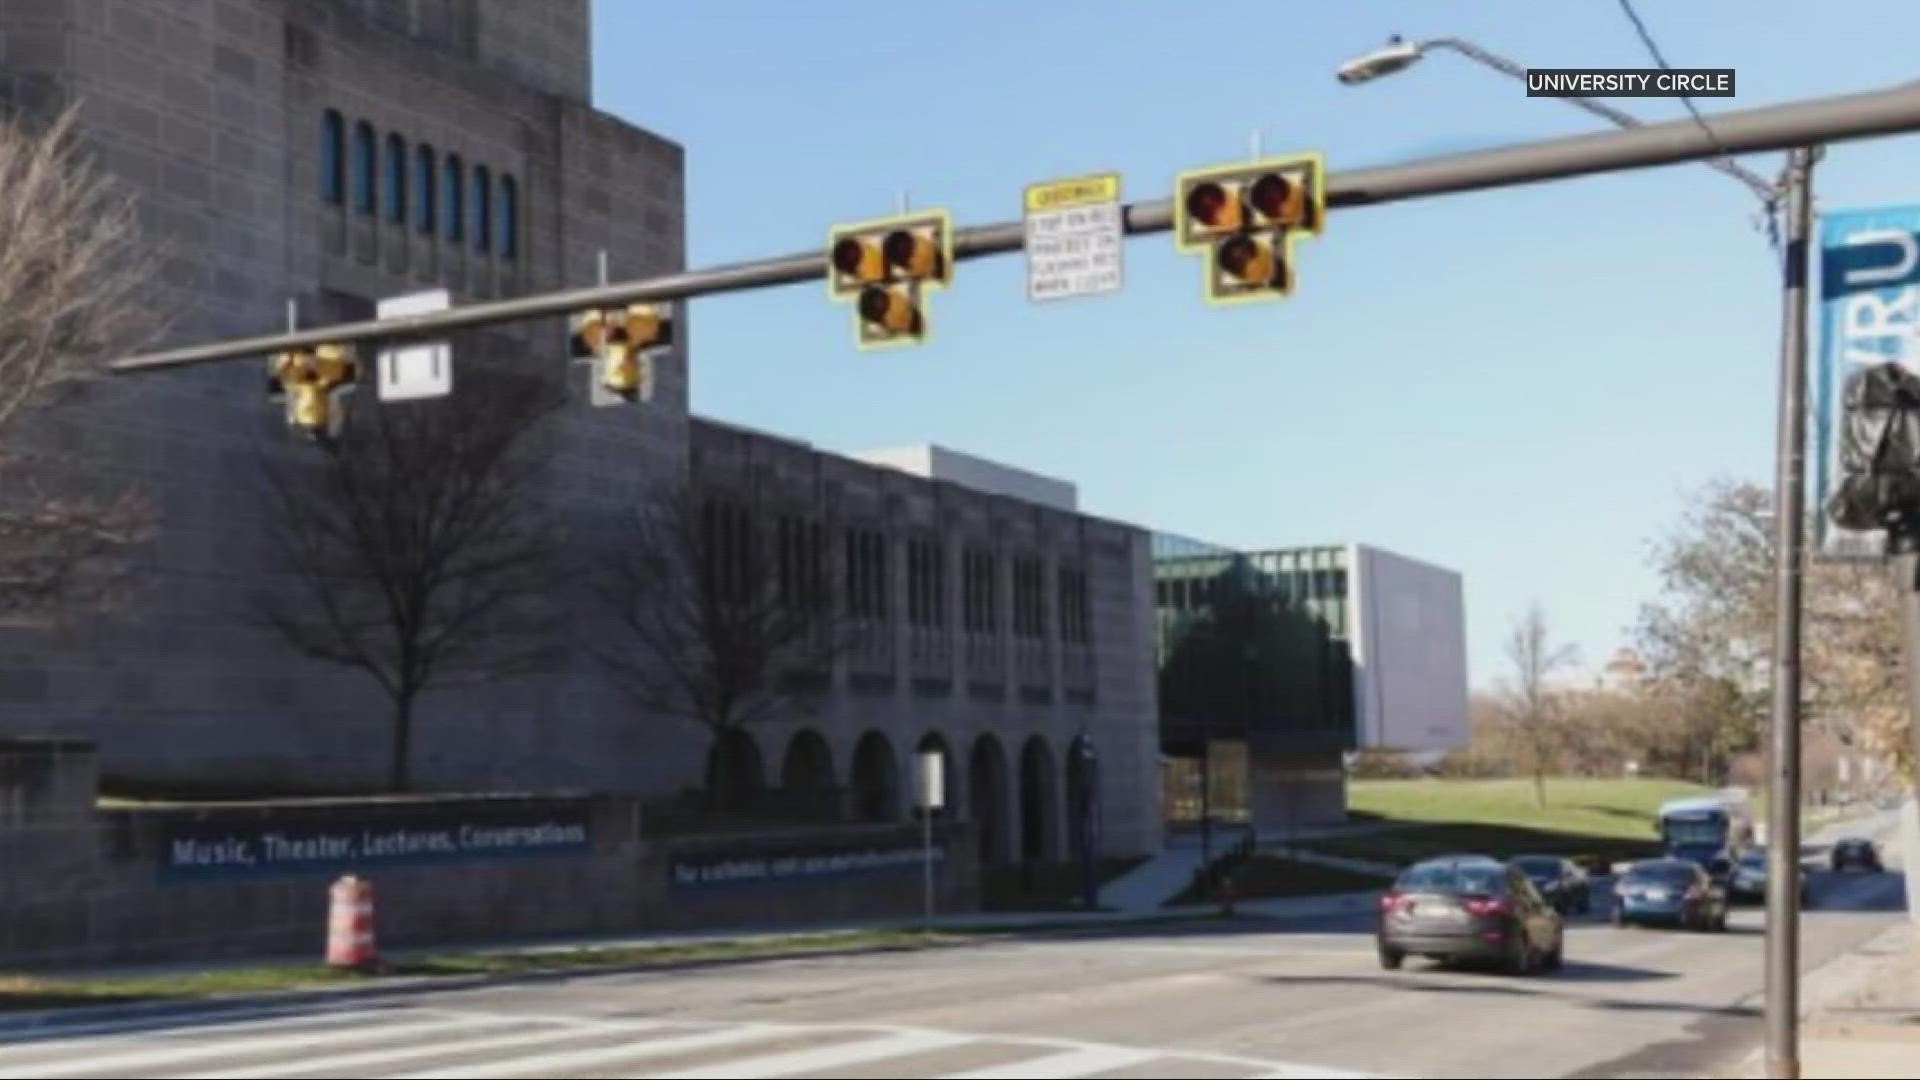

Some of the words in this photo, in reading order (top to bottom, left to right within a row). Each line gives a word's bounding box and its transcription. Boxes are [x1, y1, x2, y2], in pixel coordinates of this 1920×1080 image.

[172, 838, 256, 868] Music,
[261, 831, 357, 861] Theater,
[361, 828, 457, 857] Lectures,
[459, 821, 586, 849] Conversations
